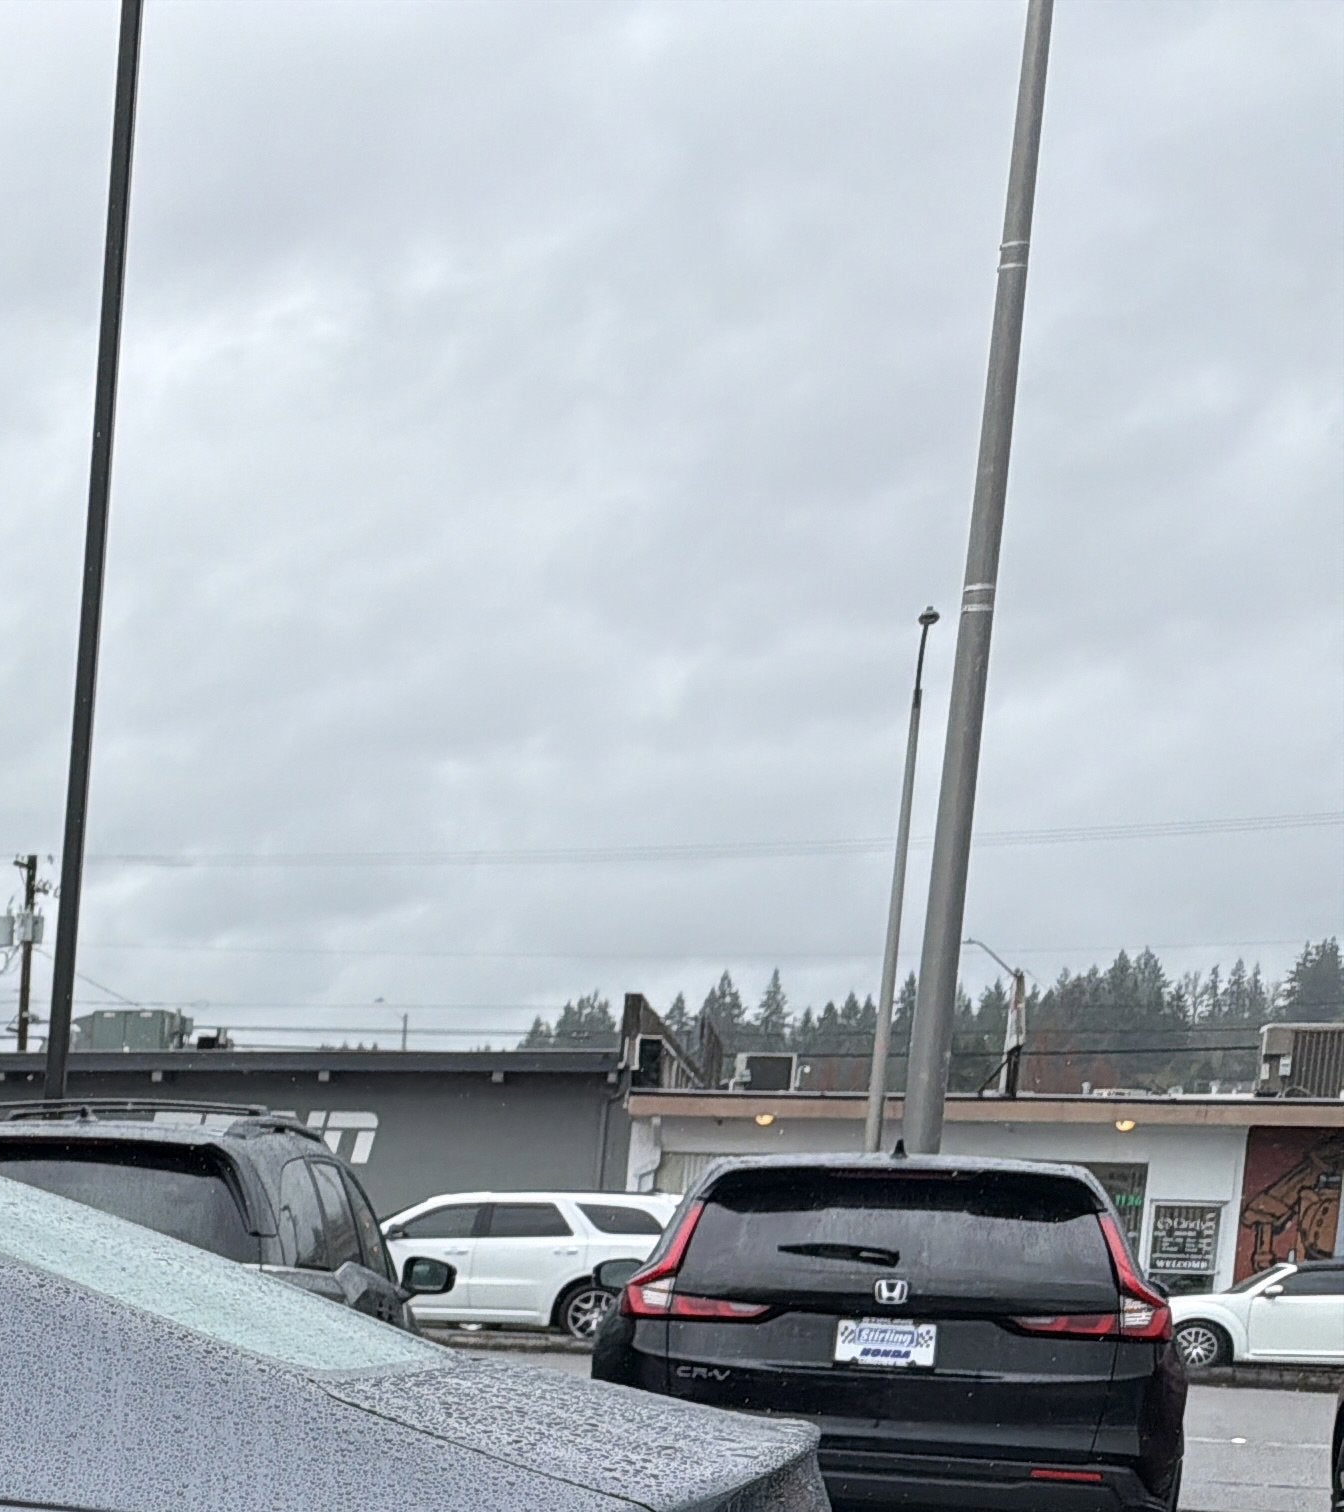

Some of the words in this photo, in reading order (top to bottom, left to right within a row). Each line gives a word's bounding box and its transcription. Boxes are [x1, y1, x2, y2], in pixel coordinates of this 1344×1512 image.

[860, 1327, 914, 1347] Stirling
[860, 1347, 912, 1359] HONDA
[676, 1365, 731, 1381] CR-V
